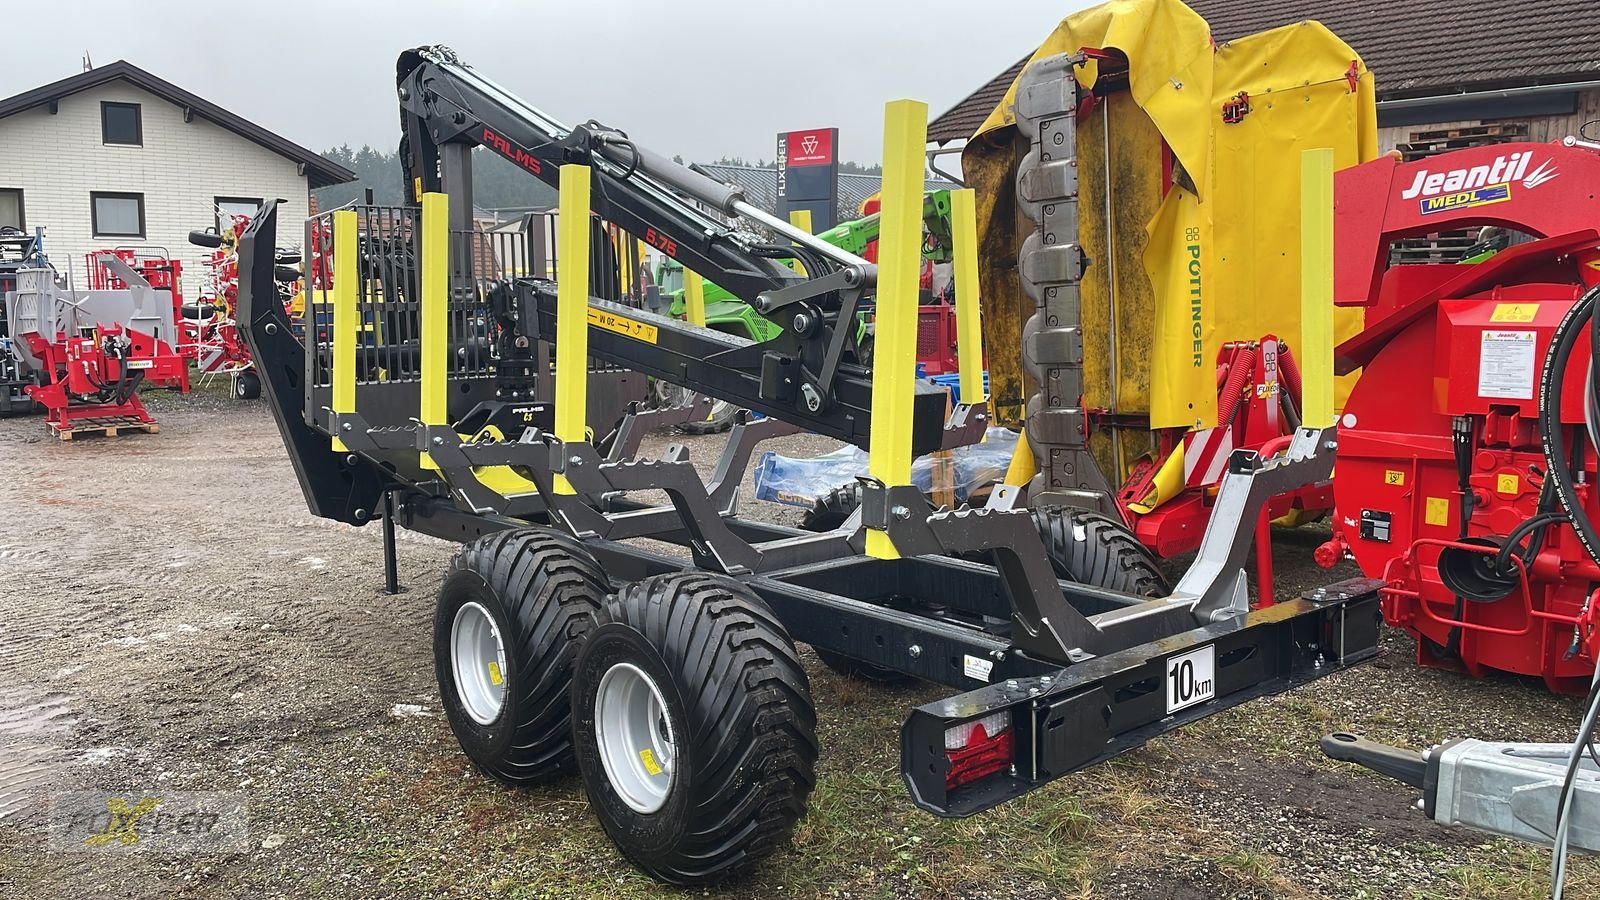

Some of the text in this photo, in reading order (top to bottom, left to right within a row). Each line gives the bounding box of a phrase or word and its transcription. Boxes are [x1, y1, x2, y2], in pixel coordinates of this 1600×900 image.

[483, 128, 541, 175] PALMS
[1402, 151, 1534, 200] Jeantil
[1428, 191, 1481, 210] MEDL
[646, 227, 677, 257] 5.75
[599, 314, 615, 327] 20 M
[1169, 659, 1212, 705] 10 km
